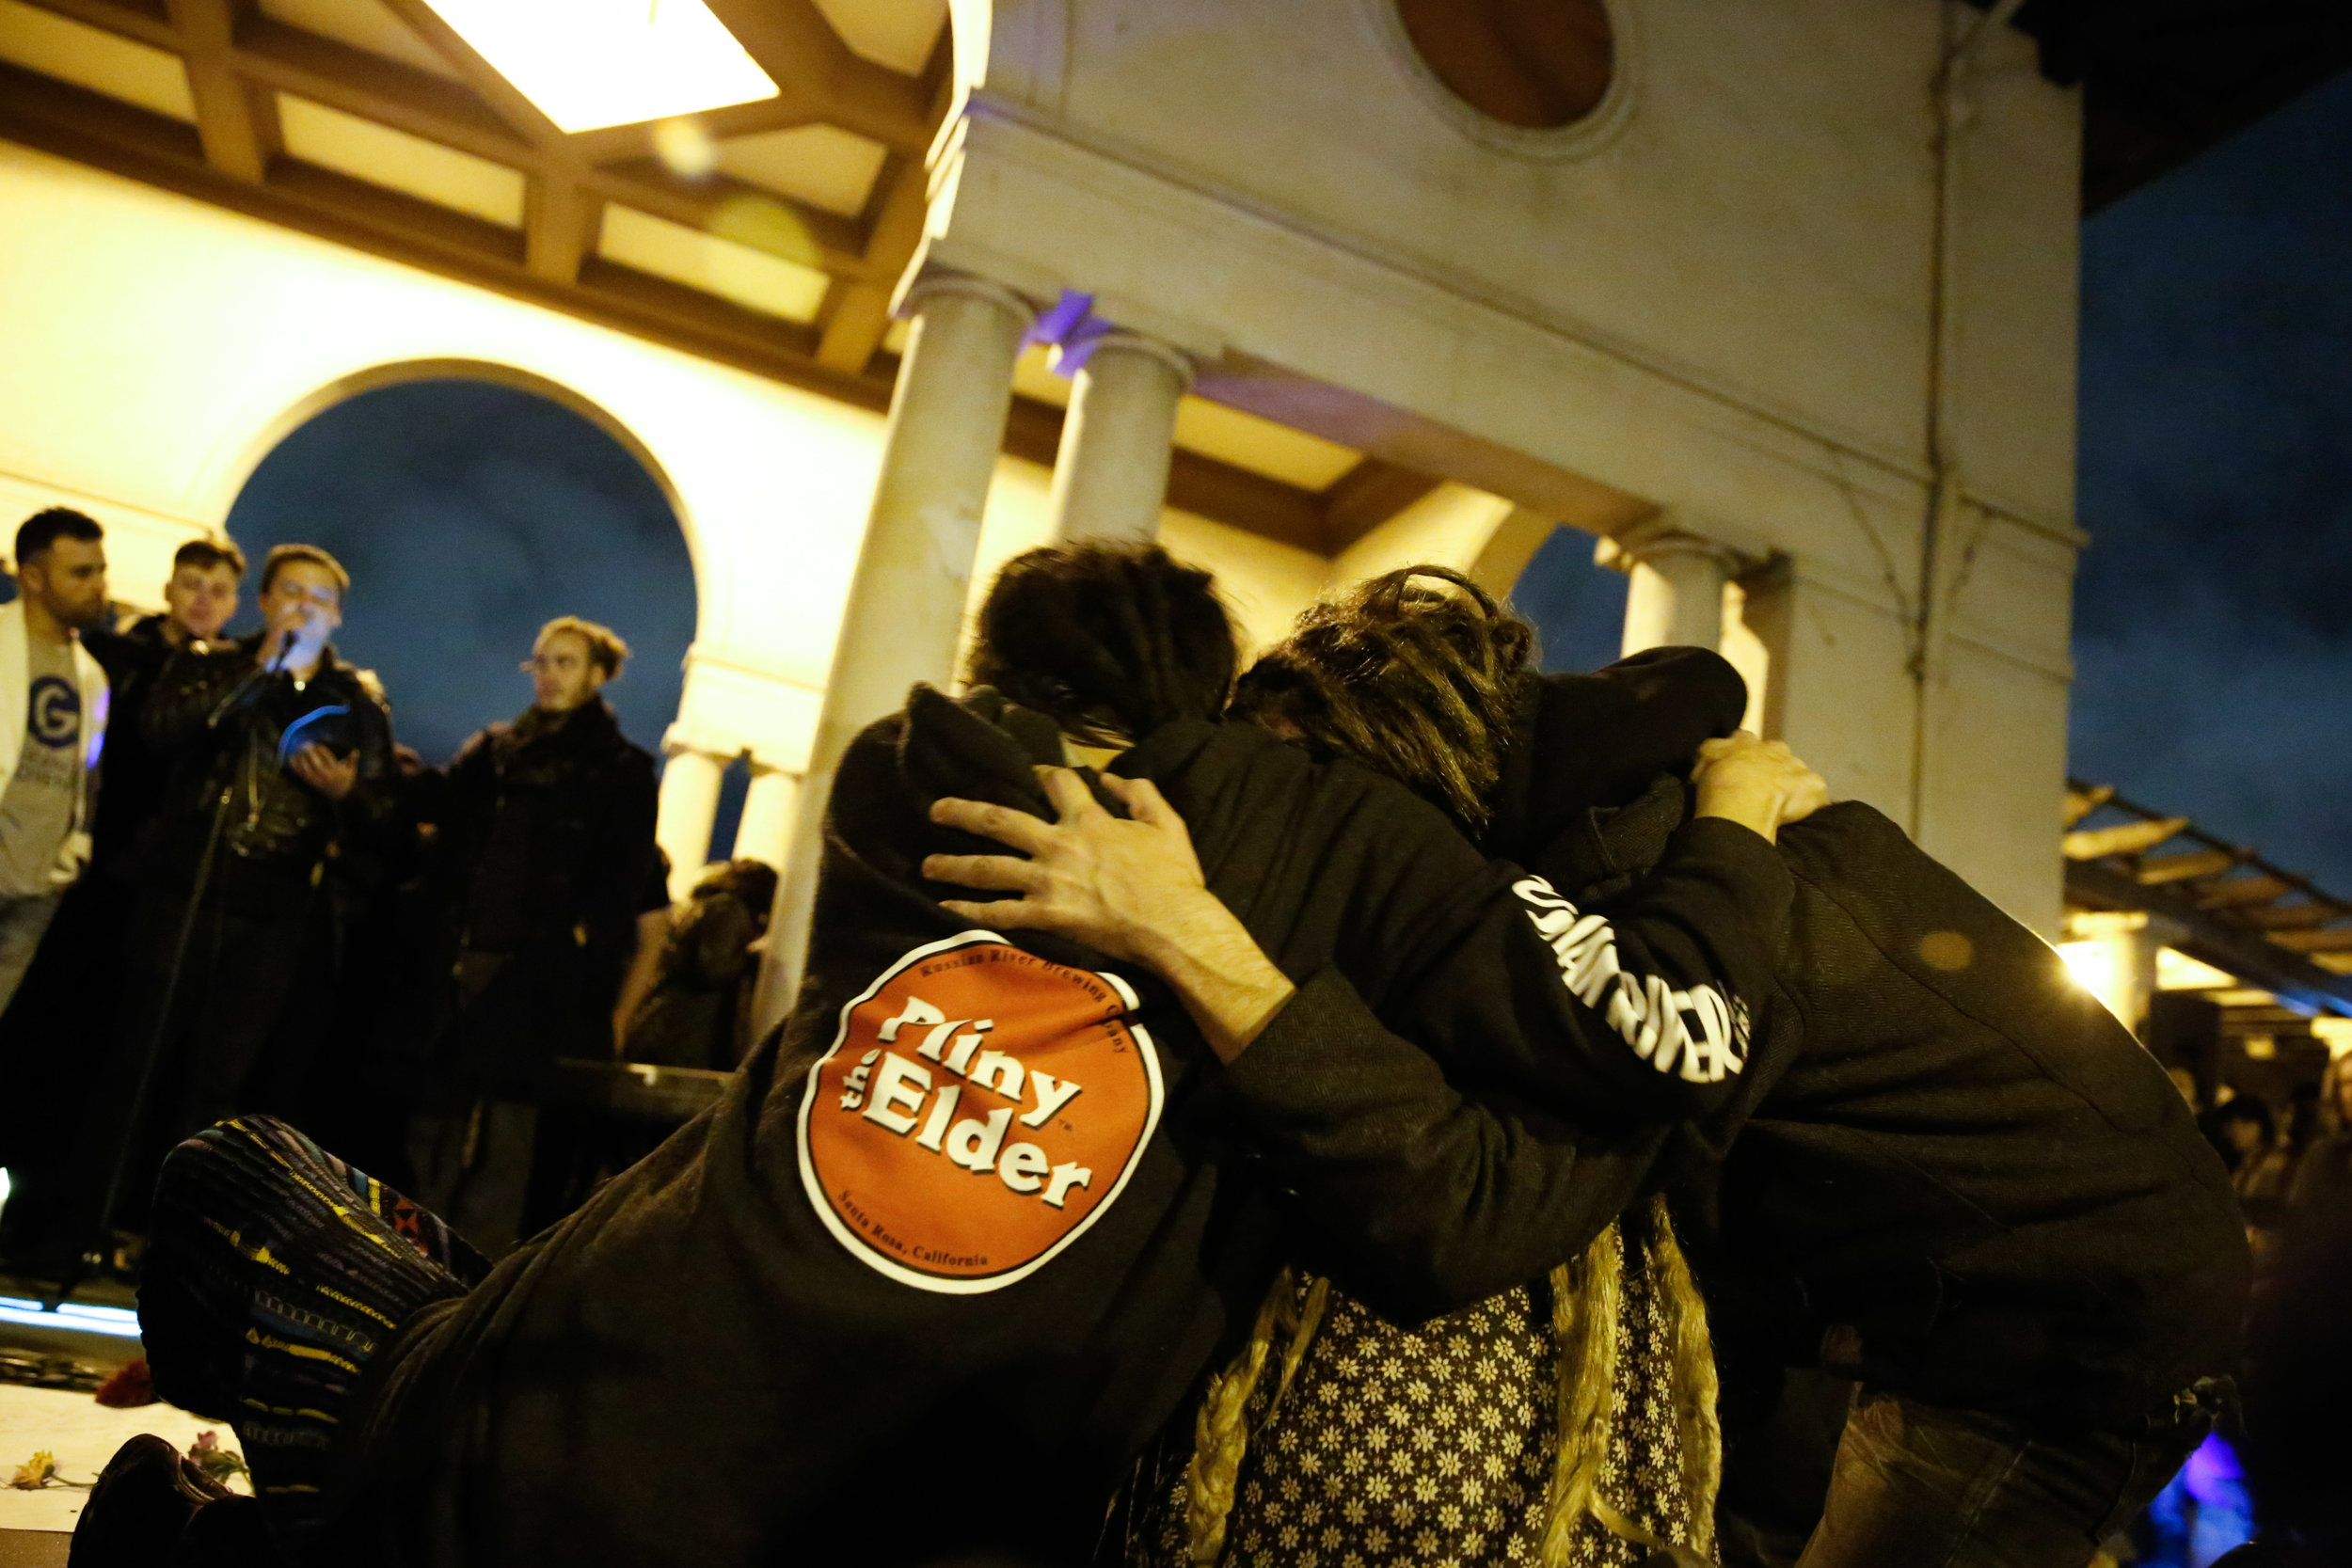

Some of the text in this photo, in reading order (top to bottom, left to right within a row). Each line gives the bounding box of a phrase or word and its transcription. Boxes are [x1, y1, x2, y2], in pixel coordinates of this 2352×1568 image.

[921, 953, 984, 977] Russian
[990, 949, 1036, 965] River
[1041, 959, 1106, 1003] Brewing
[877, 995, 1083, 1128] Pliny
[840, 1048, 1093, 1208] the Elder
[838, 1190, 988, 1267] Santa Rosa, California
